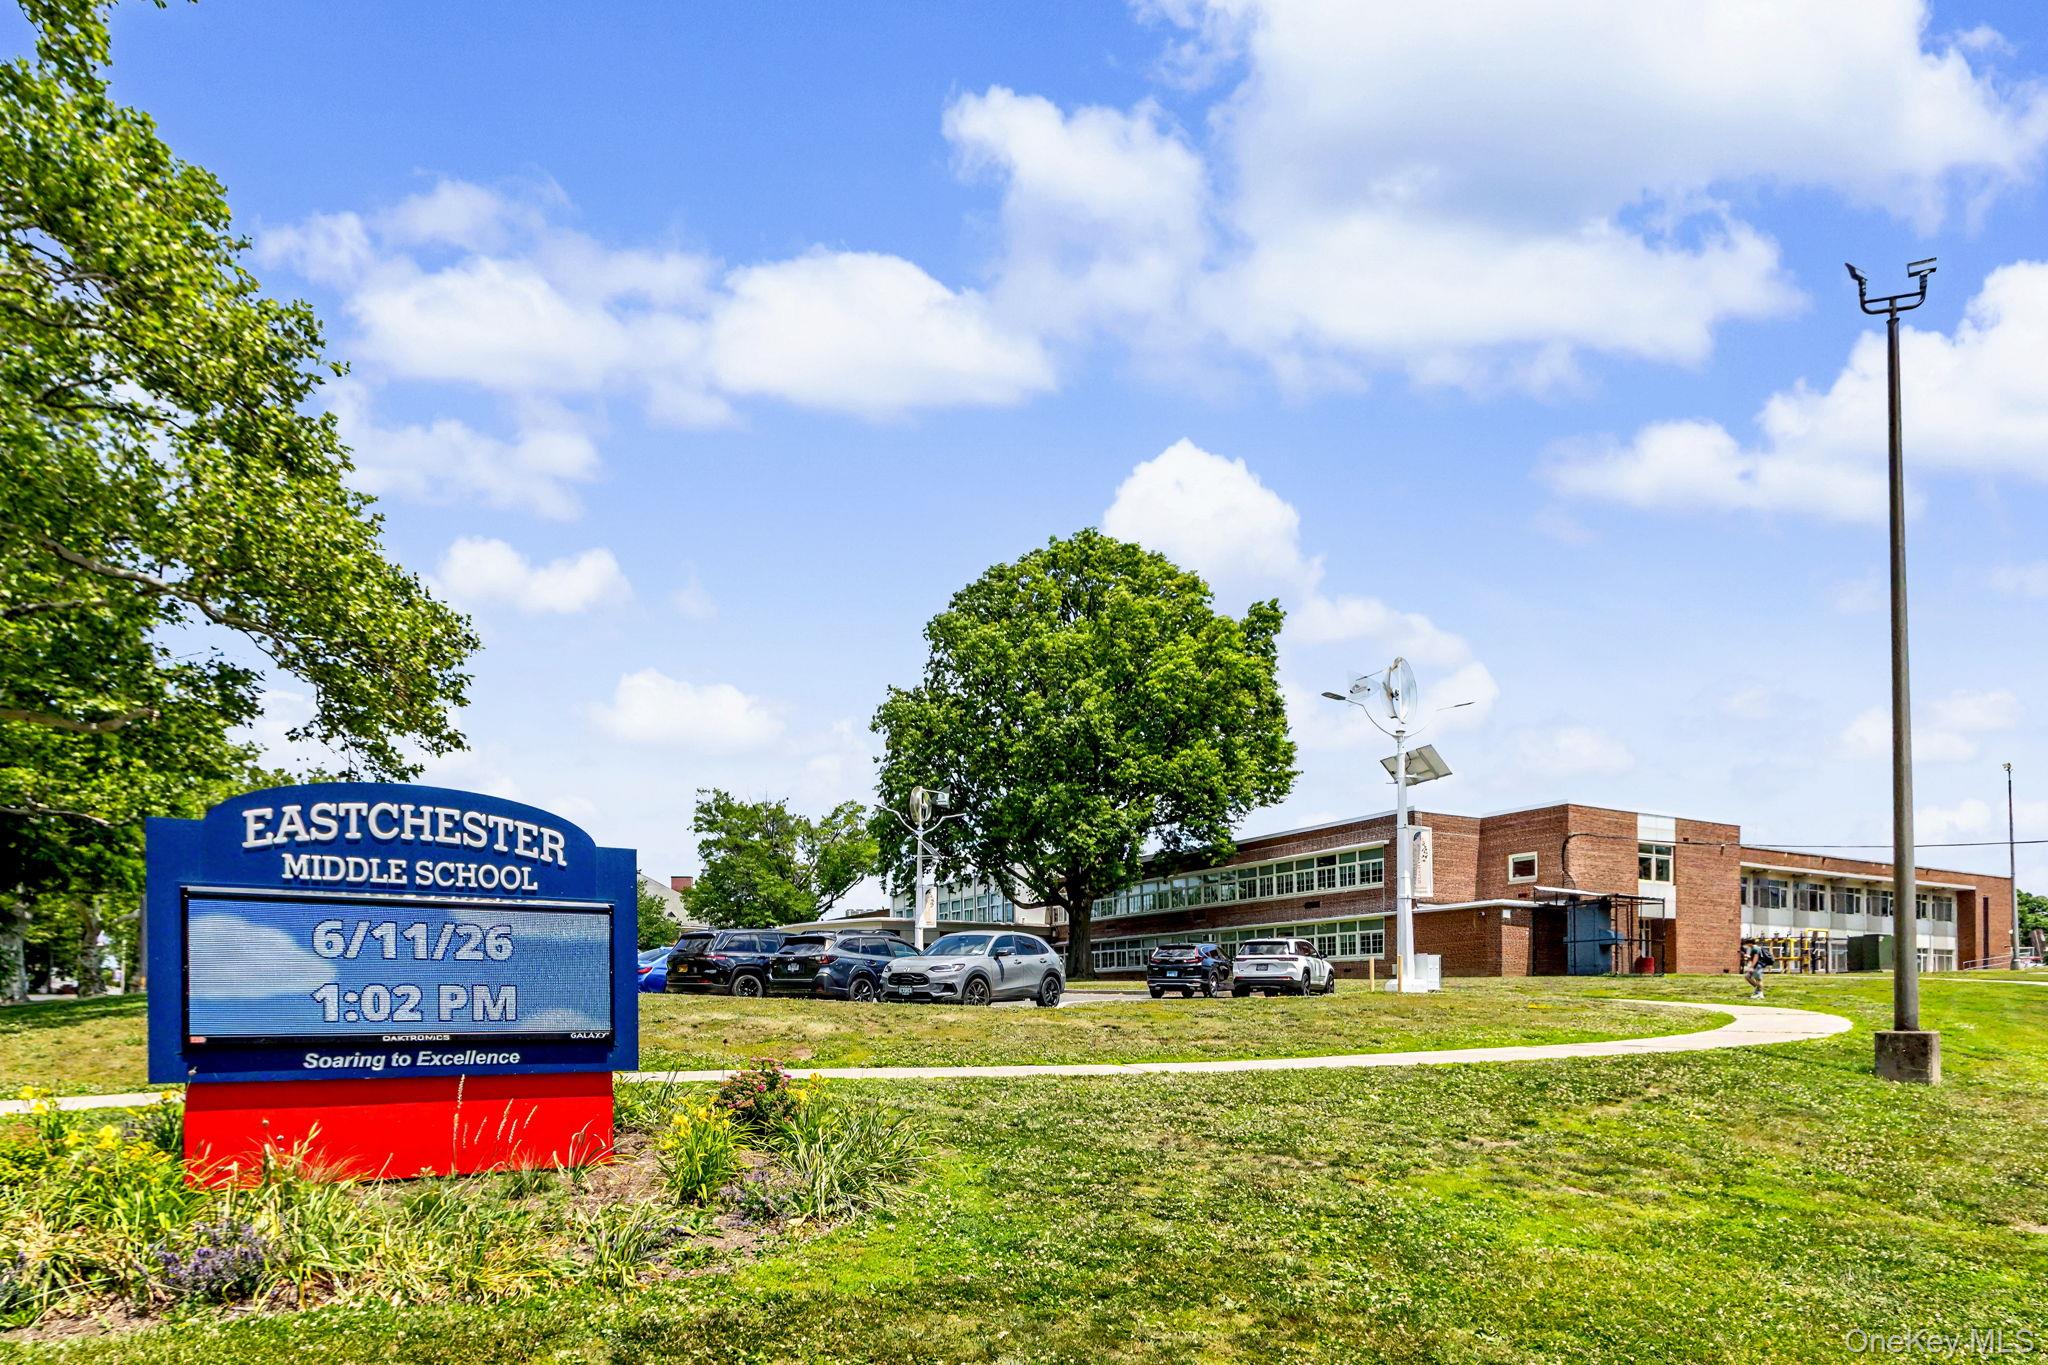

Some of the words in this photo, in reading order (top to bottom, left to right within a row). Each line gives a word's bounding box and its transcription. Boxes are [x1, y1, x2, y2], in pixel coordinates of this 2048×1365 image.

[242, 802, 567, 867] EASTCHESTER
[281, 853, 408, 885] MIDDLE
[415, 861, 538, 891] SCHOOL
[312, 919, 515, 961] 6/11/26
[311, 983, 423, 1023] 1:02
[438, 984, 518, 1022] PM
[382, 1034, 451, 1042] DAKTRONICS
[303, 1052, 385, 1071] Soaring
[391, 1052, 411, 1067] to
[416, 1050, 521, 1066] Excellence
